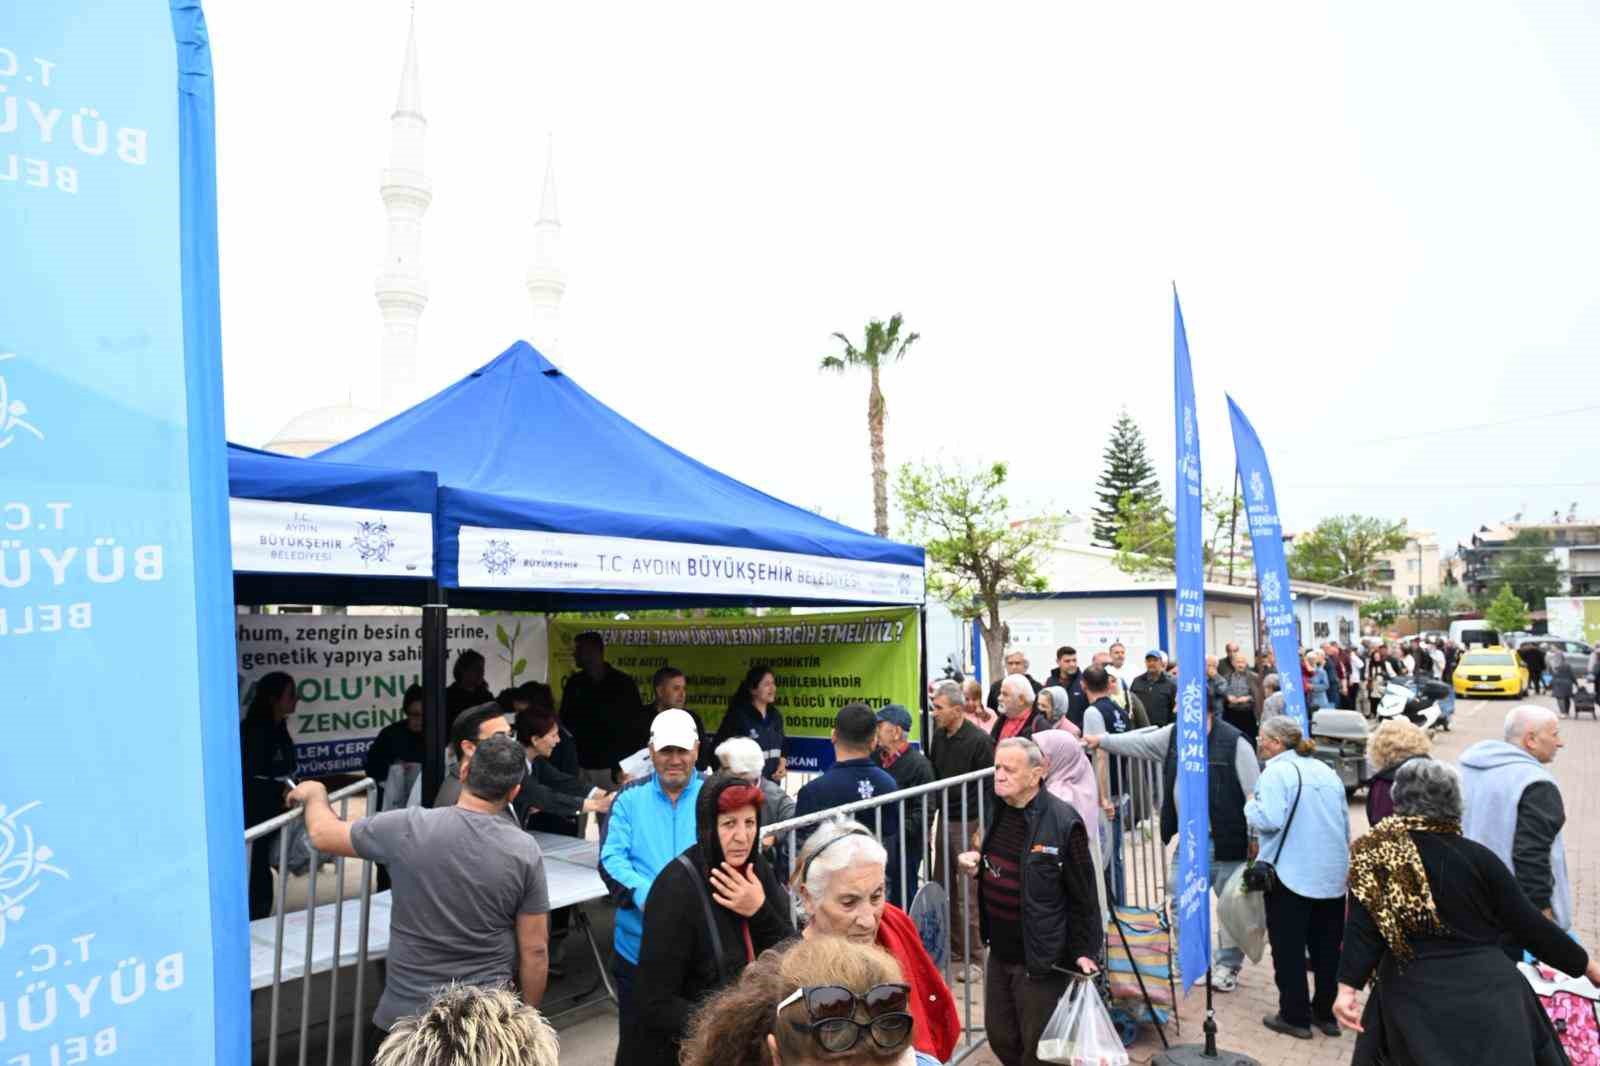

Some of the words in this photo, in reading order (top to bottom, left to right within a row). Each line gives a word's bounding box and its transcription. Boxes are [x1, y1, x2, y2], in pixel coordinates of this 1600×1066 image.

[632, 557, 681, 576] AYDIN
[687, 554, 793, 585] BÜYÜKŞEHİR
[296, 623, 359, 645] zengin
[364, 622, 410, 640] besin
[768, 620, 816, 645] TERCİH
[818, 616, 893, 643] ETMELİYİZ
[242, 647, 318, 670] genetik
[323, 649, 382, 668] yapıya
